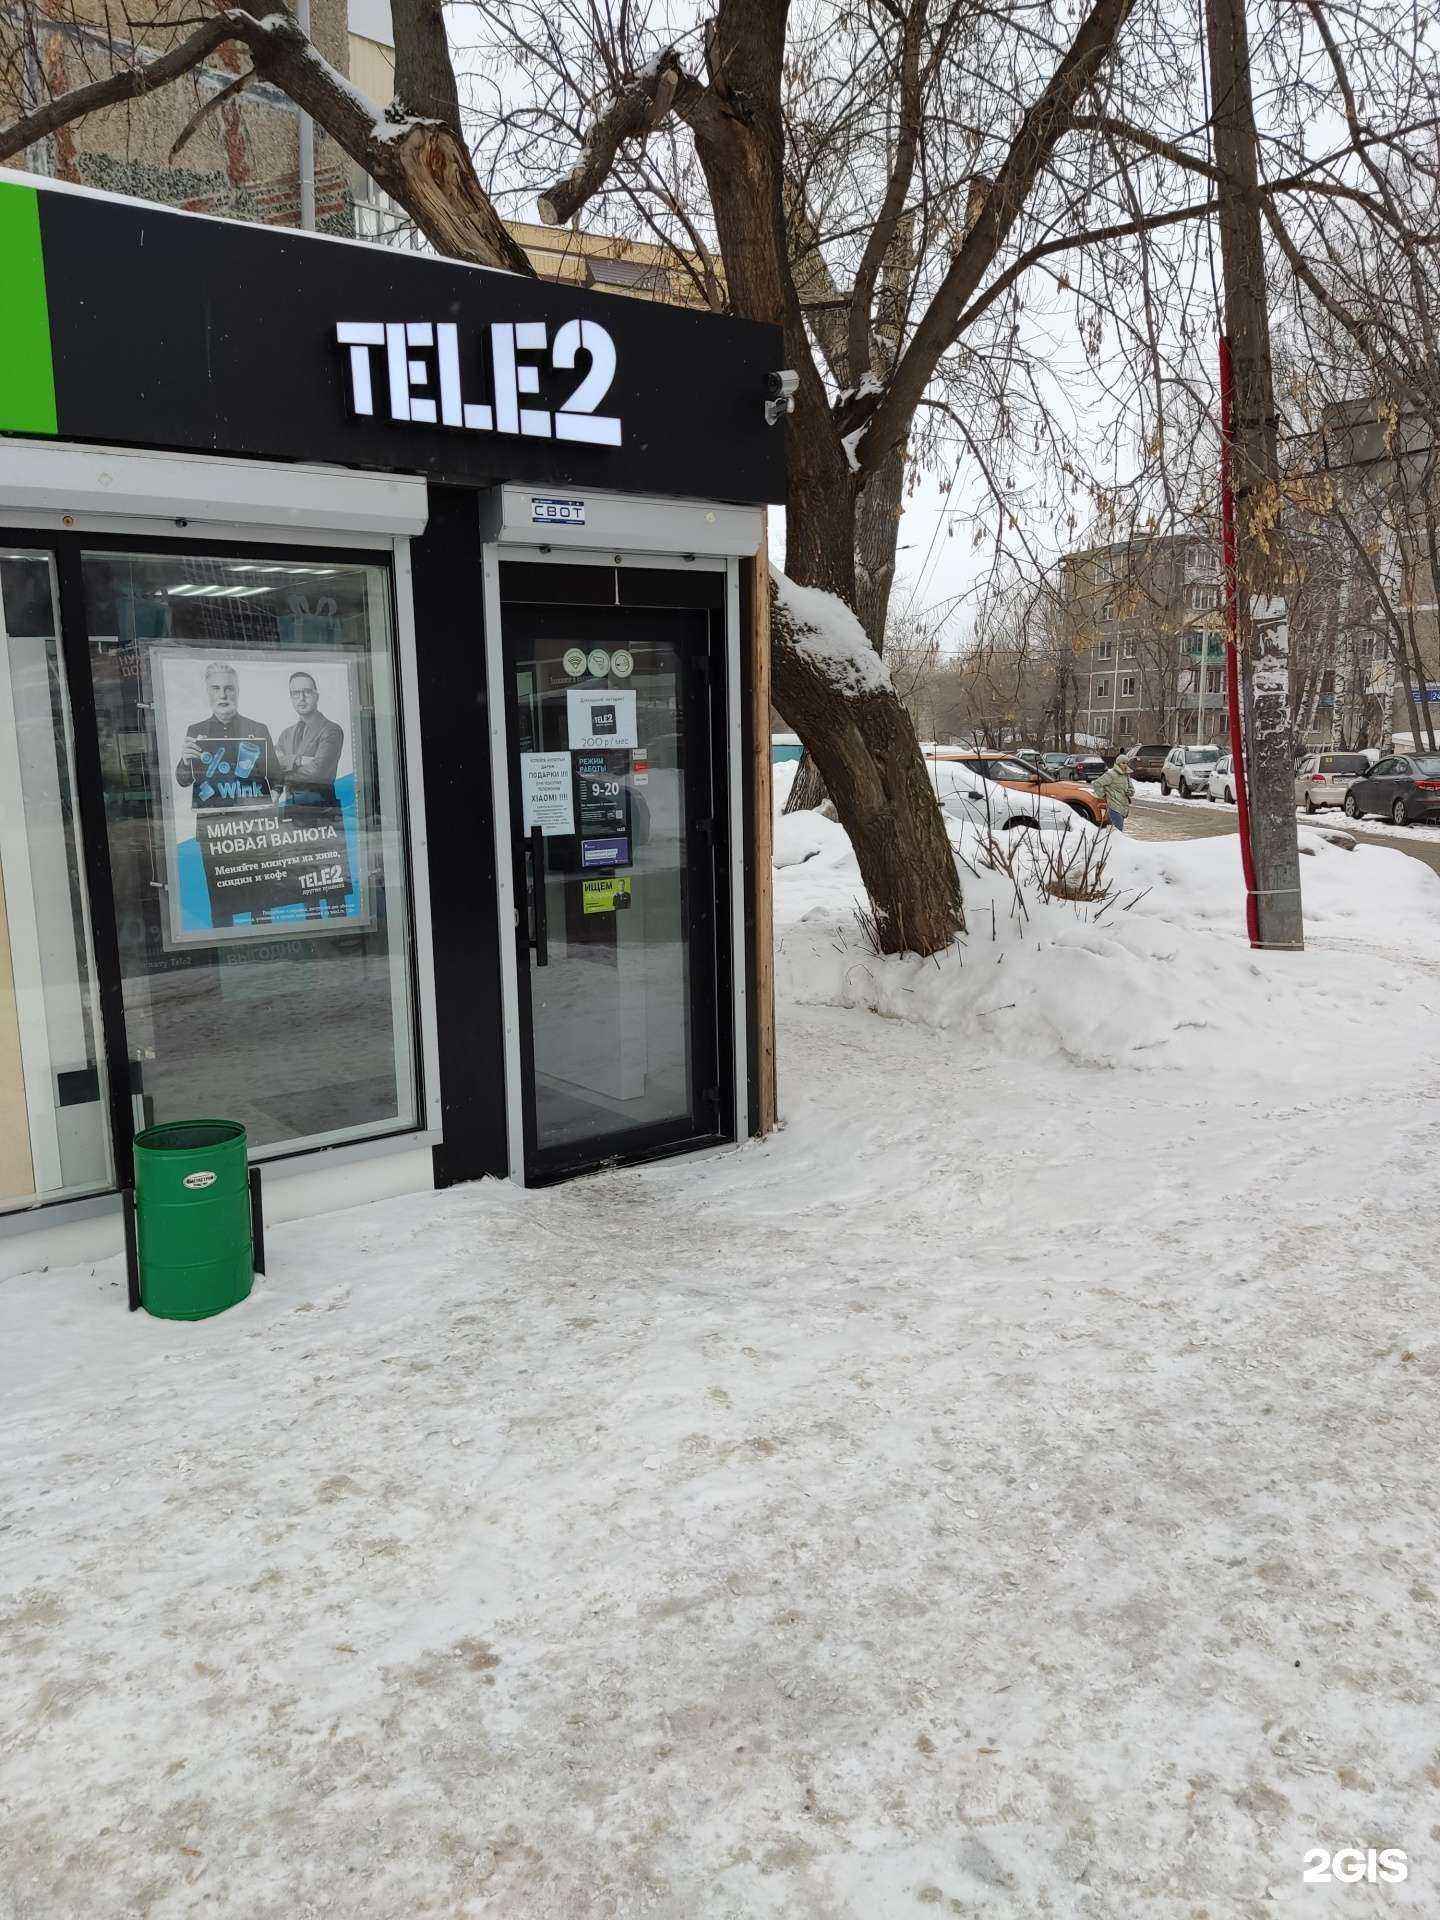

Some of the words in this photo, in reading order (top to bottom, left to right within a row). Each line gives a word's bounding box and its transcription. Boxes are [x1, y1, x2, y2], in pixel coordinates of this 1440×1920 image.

[336, 319, 622, 447] TELE2
[594, 713, 614, 724] TELE2
[578, 757, 604, 765] РЕЖИМ
[579, 765, 608, 773] РАБОТЫ
[217, 780, 264, 799] Wink
[531, 793, 557, 802] XIAOMI
[591, 782, 620, 797] 9-20
[206, 816, 280, 839] МИНУТЫ
[208, 834, 268, 855] НОВАЯ
[270, 825, 338, 847] ВАЛЮТА
[214, 862, 259, 876] Меняйте
[261, 855, 300, 872] минуты
[216, 874, 253, 888] скидки
[254, 873, 263, 882] и
[264, 868, 288, 881] кофе
[298, 864, 344, 889] TELE2
[584, 880, 613, 893] ИЩЕМ
